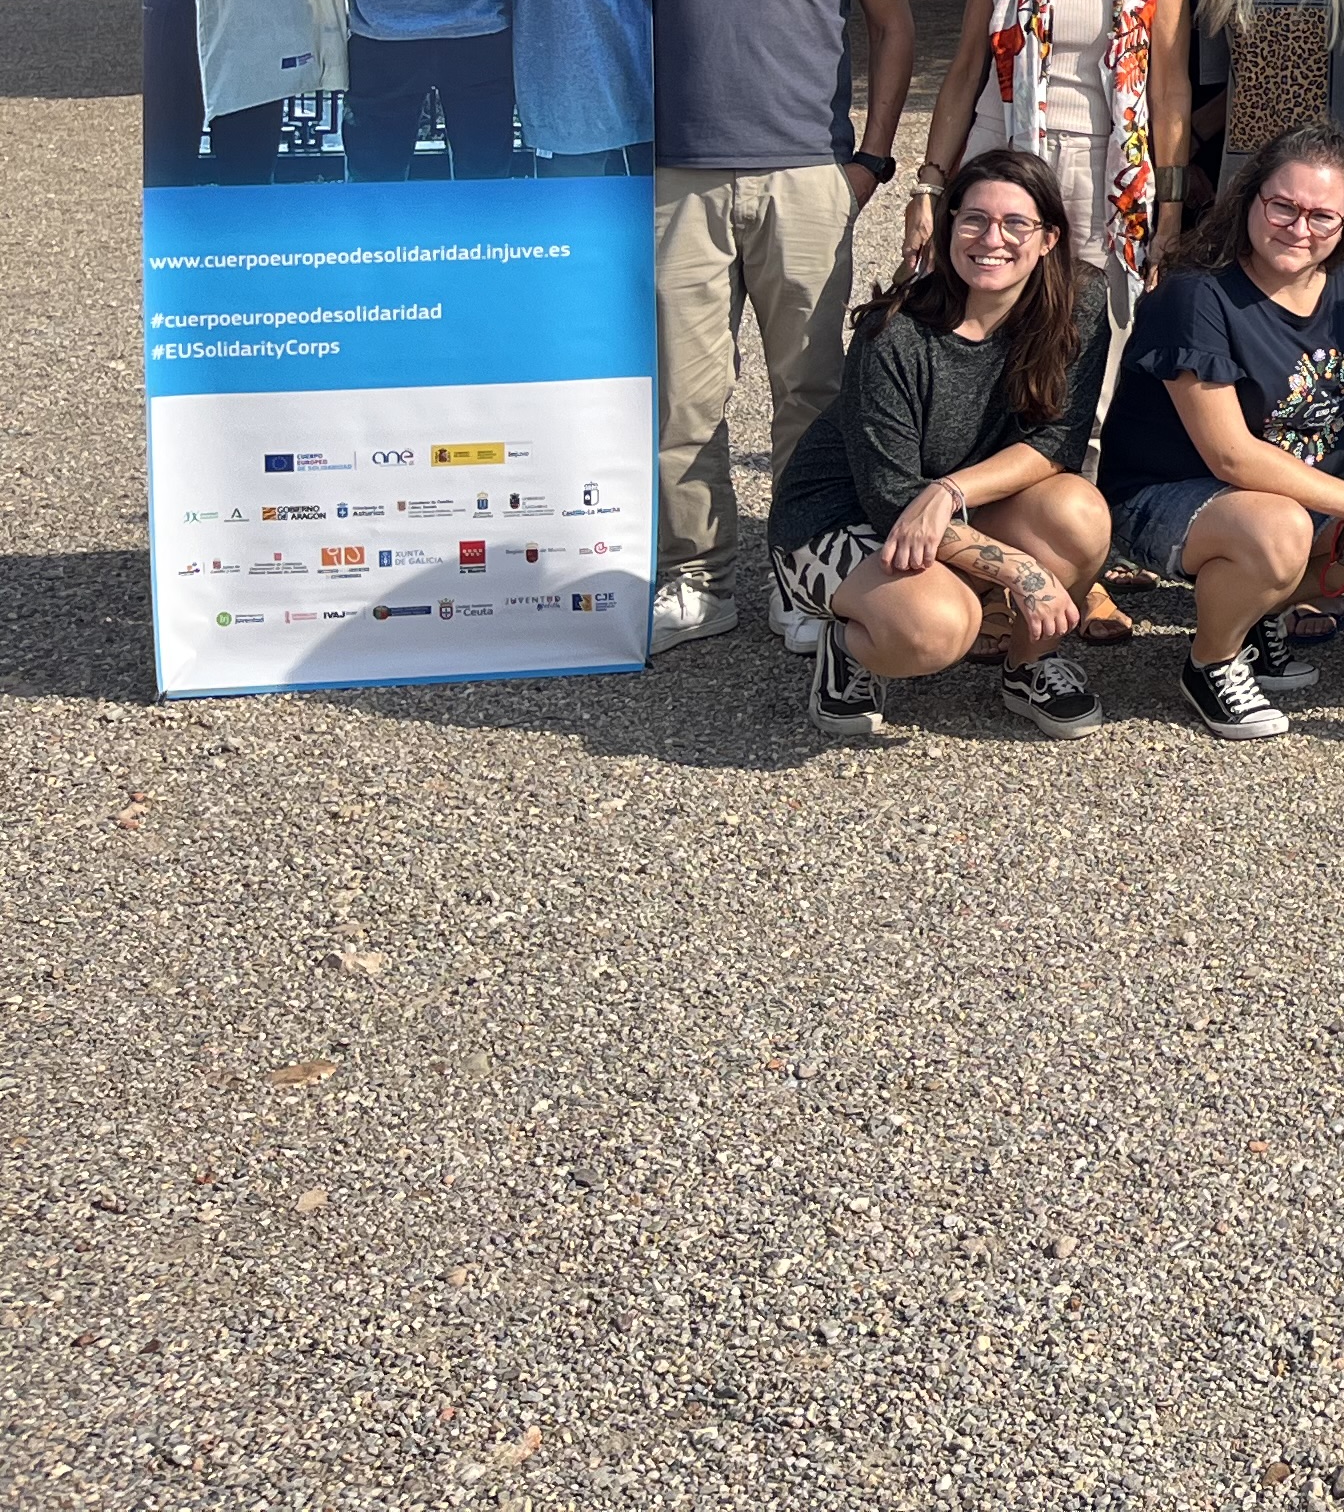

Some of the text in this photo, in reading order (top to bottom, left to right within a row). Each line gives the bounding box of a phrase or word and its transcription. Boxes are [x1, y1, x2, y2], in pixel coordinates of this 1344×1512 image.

[149, 243, 571, 271] www.cuerpoeuropeodesolidaridad.injuve.es
[151, 303, 442, 331] #cuerpoeuropeodesolidaridad
[152, 339, 341, 361] #EUSolidarityCorps
[277, 505, 320, 513] GOBIERNO
[277, 512, 288, 521] DE
[395, 550, 425, 558] XUNTA
[395, 556, 443, 566] DE GALICIA
[595, 592, 615, 602] CJE
[323, 611, 346, 619] IVAJ
[463, 607, 493, 617] Ceuta
